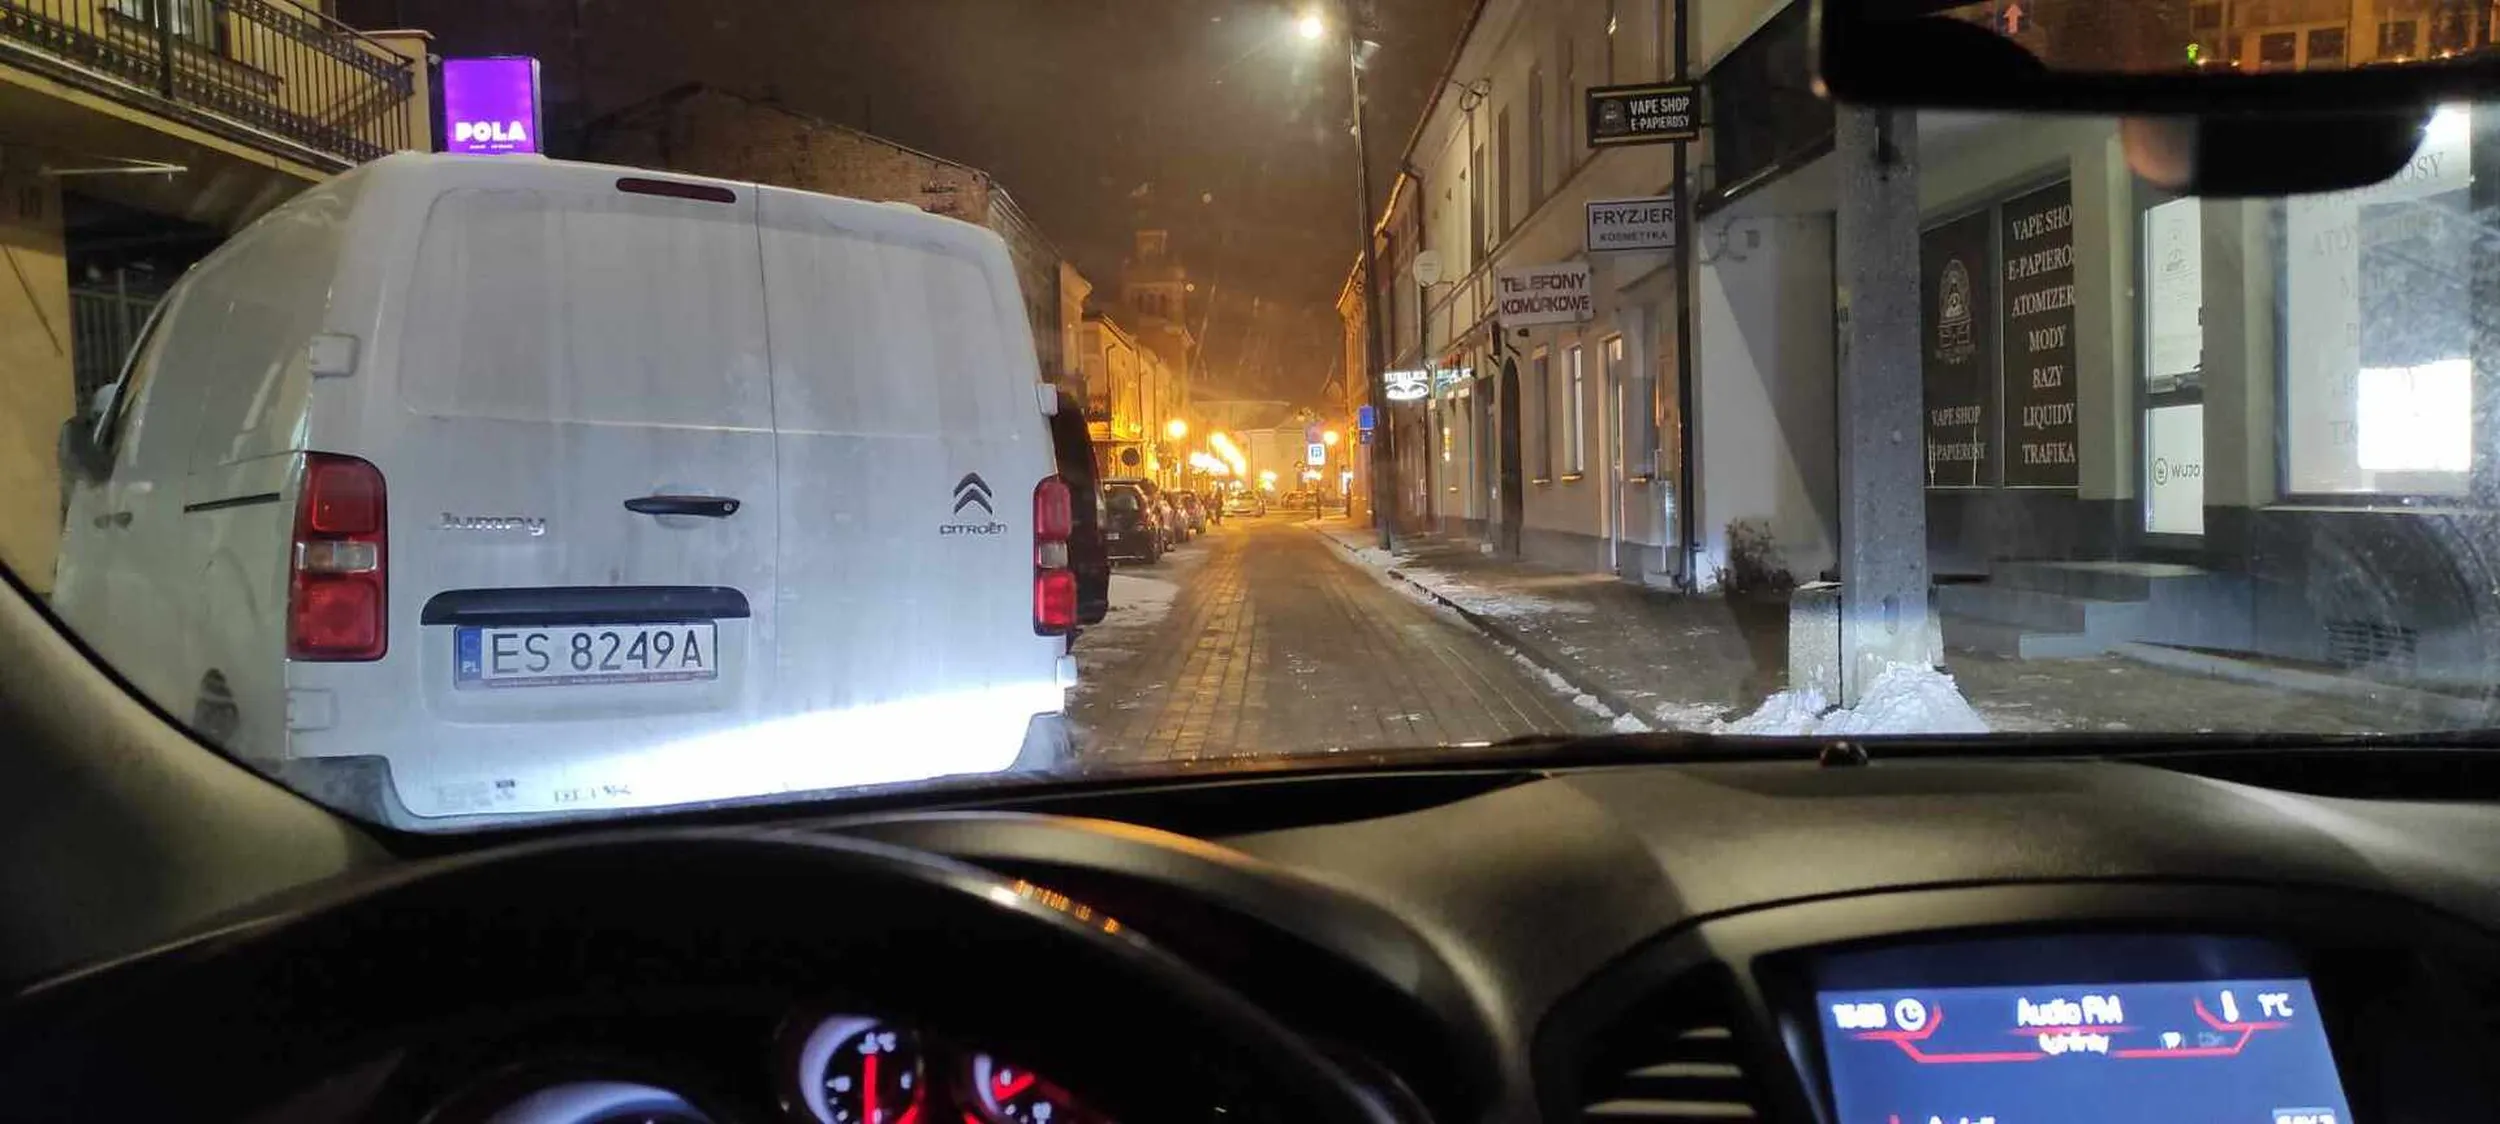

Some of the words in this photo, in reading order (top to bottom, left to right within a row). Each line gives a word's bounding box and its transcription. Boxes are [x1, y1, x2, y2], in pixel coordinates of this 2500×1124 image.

[1630, 98, 1659, 116] VAPE
[1661, 96, 1690, 114] SHOP
[455, 120, 527, 142] POLA
[1631, 115, 1690, 132] E-PAPIEROSY
[1593, 207, 1674, 225] FRYZJER
[2013, 213, 2045, 241] VAPE
[2046, 203, 2073, 232] SHO
[2008, 244, 2074, 281] E-PAPIERO
[1501, 272, 1586, 293] TELEFONY
[1502, 292, 1590, 315] KOMÓRKOWE
[2028, 324, 2067, 352] MODY
[2032, 364, 2064, 389] BAZY
[2023, 403, 2074, 430] LIQUIDY
[2021, 442, 2076, 464] TRAFIKA
[440, 510, 546, 536] Jumpy
[491, 633, 551, 674] ES
[570, 629, 703, 672] 8249A
[462, 661, 481, 673] PL
[2082, 995, 2123, 1025] FM
